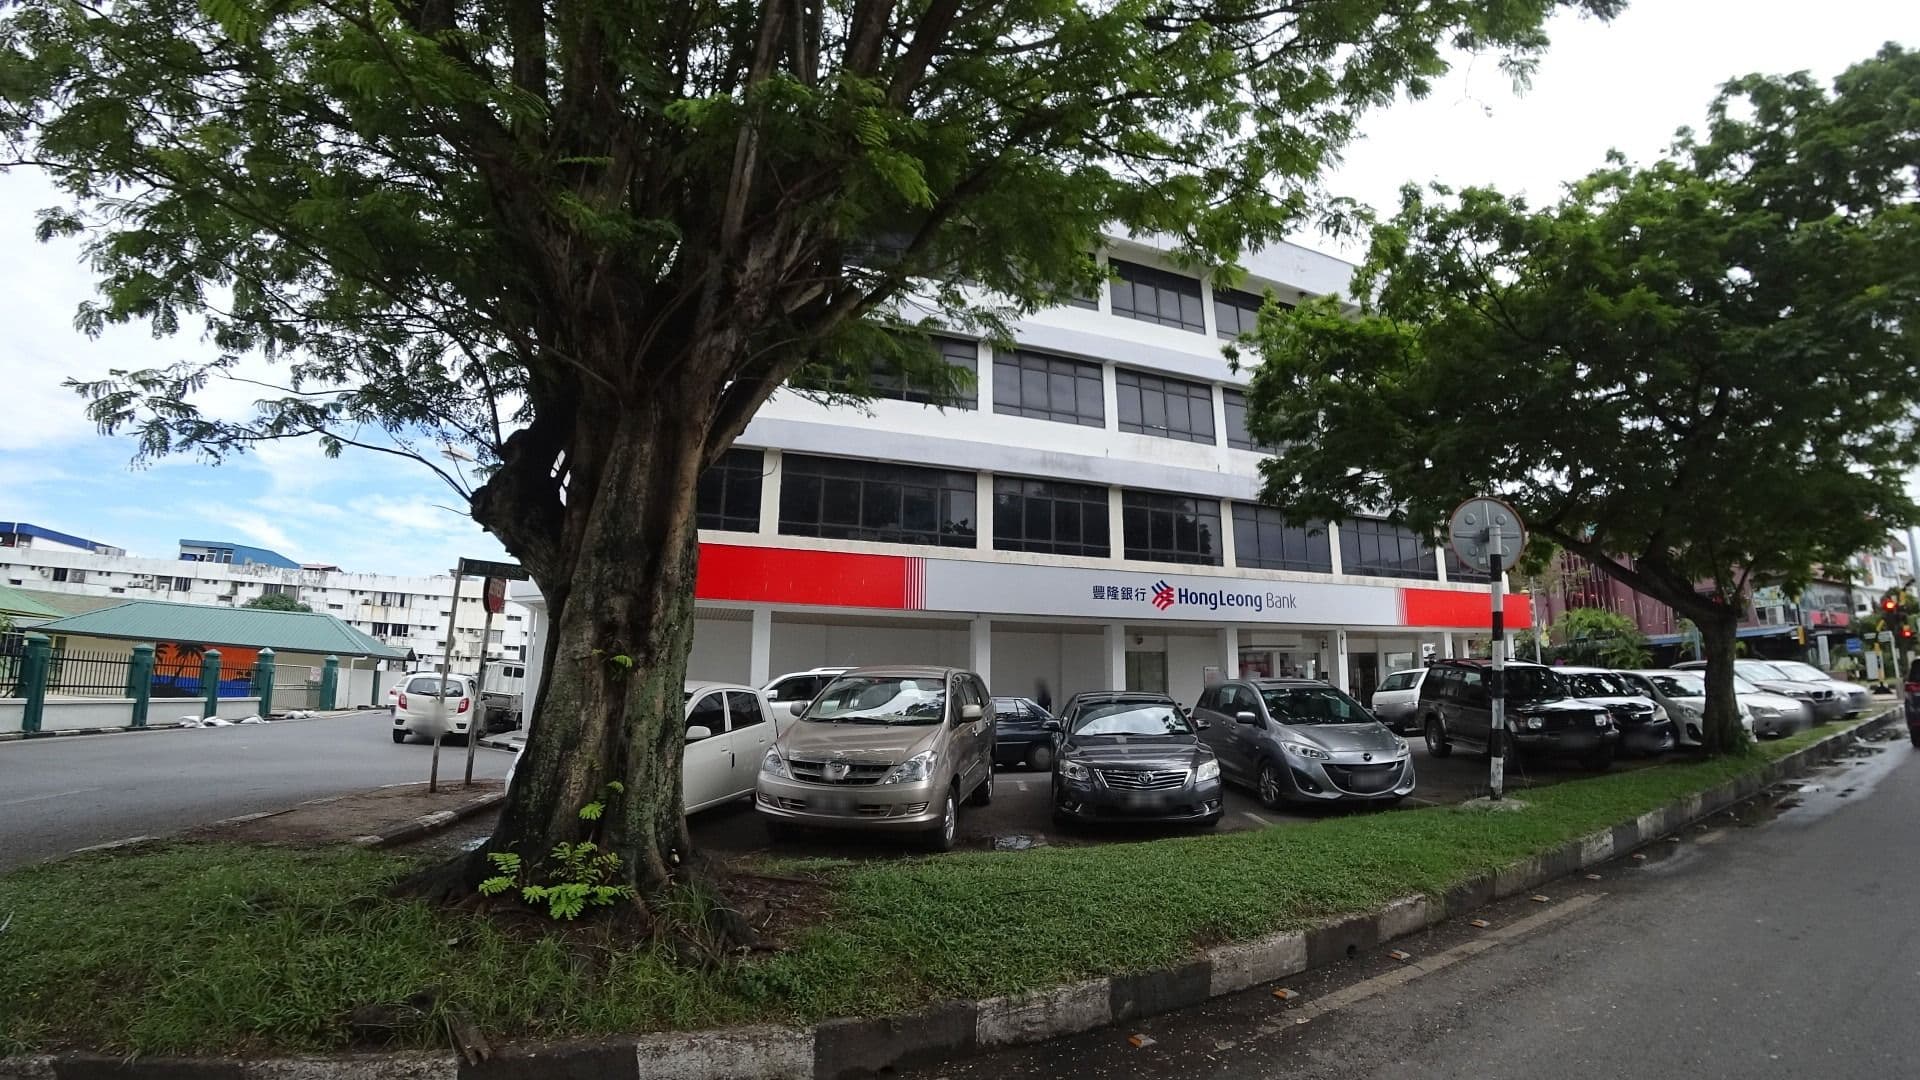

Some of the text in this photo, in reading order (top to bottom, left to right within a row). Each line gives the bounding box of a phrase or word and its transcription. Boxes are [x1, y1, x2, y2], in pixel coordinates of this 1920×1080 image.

[1092, 585, 1297, 611] 豐隆銀行 HongLeong Bank
